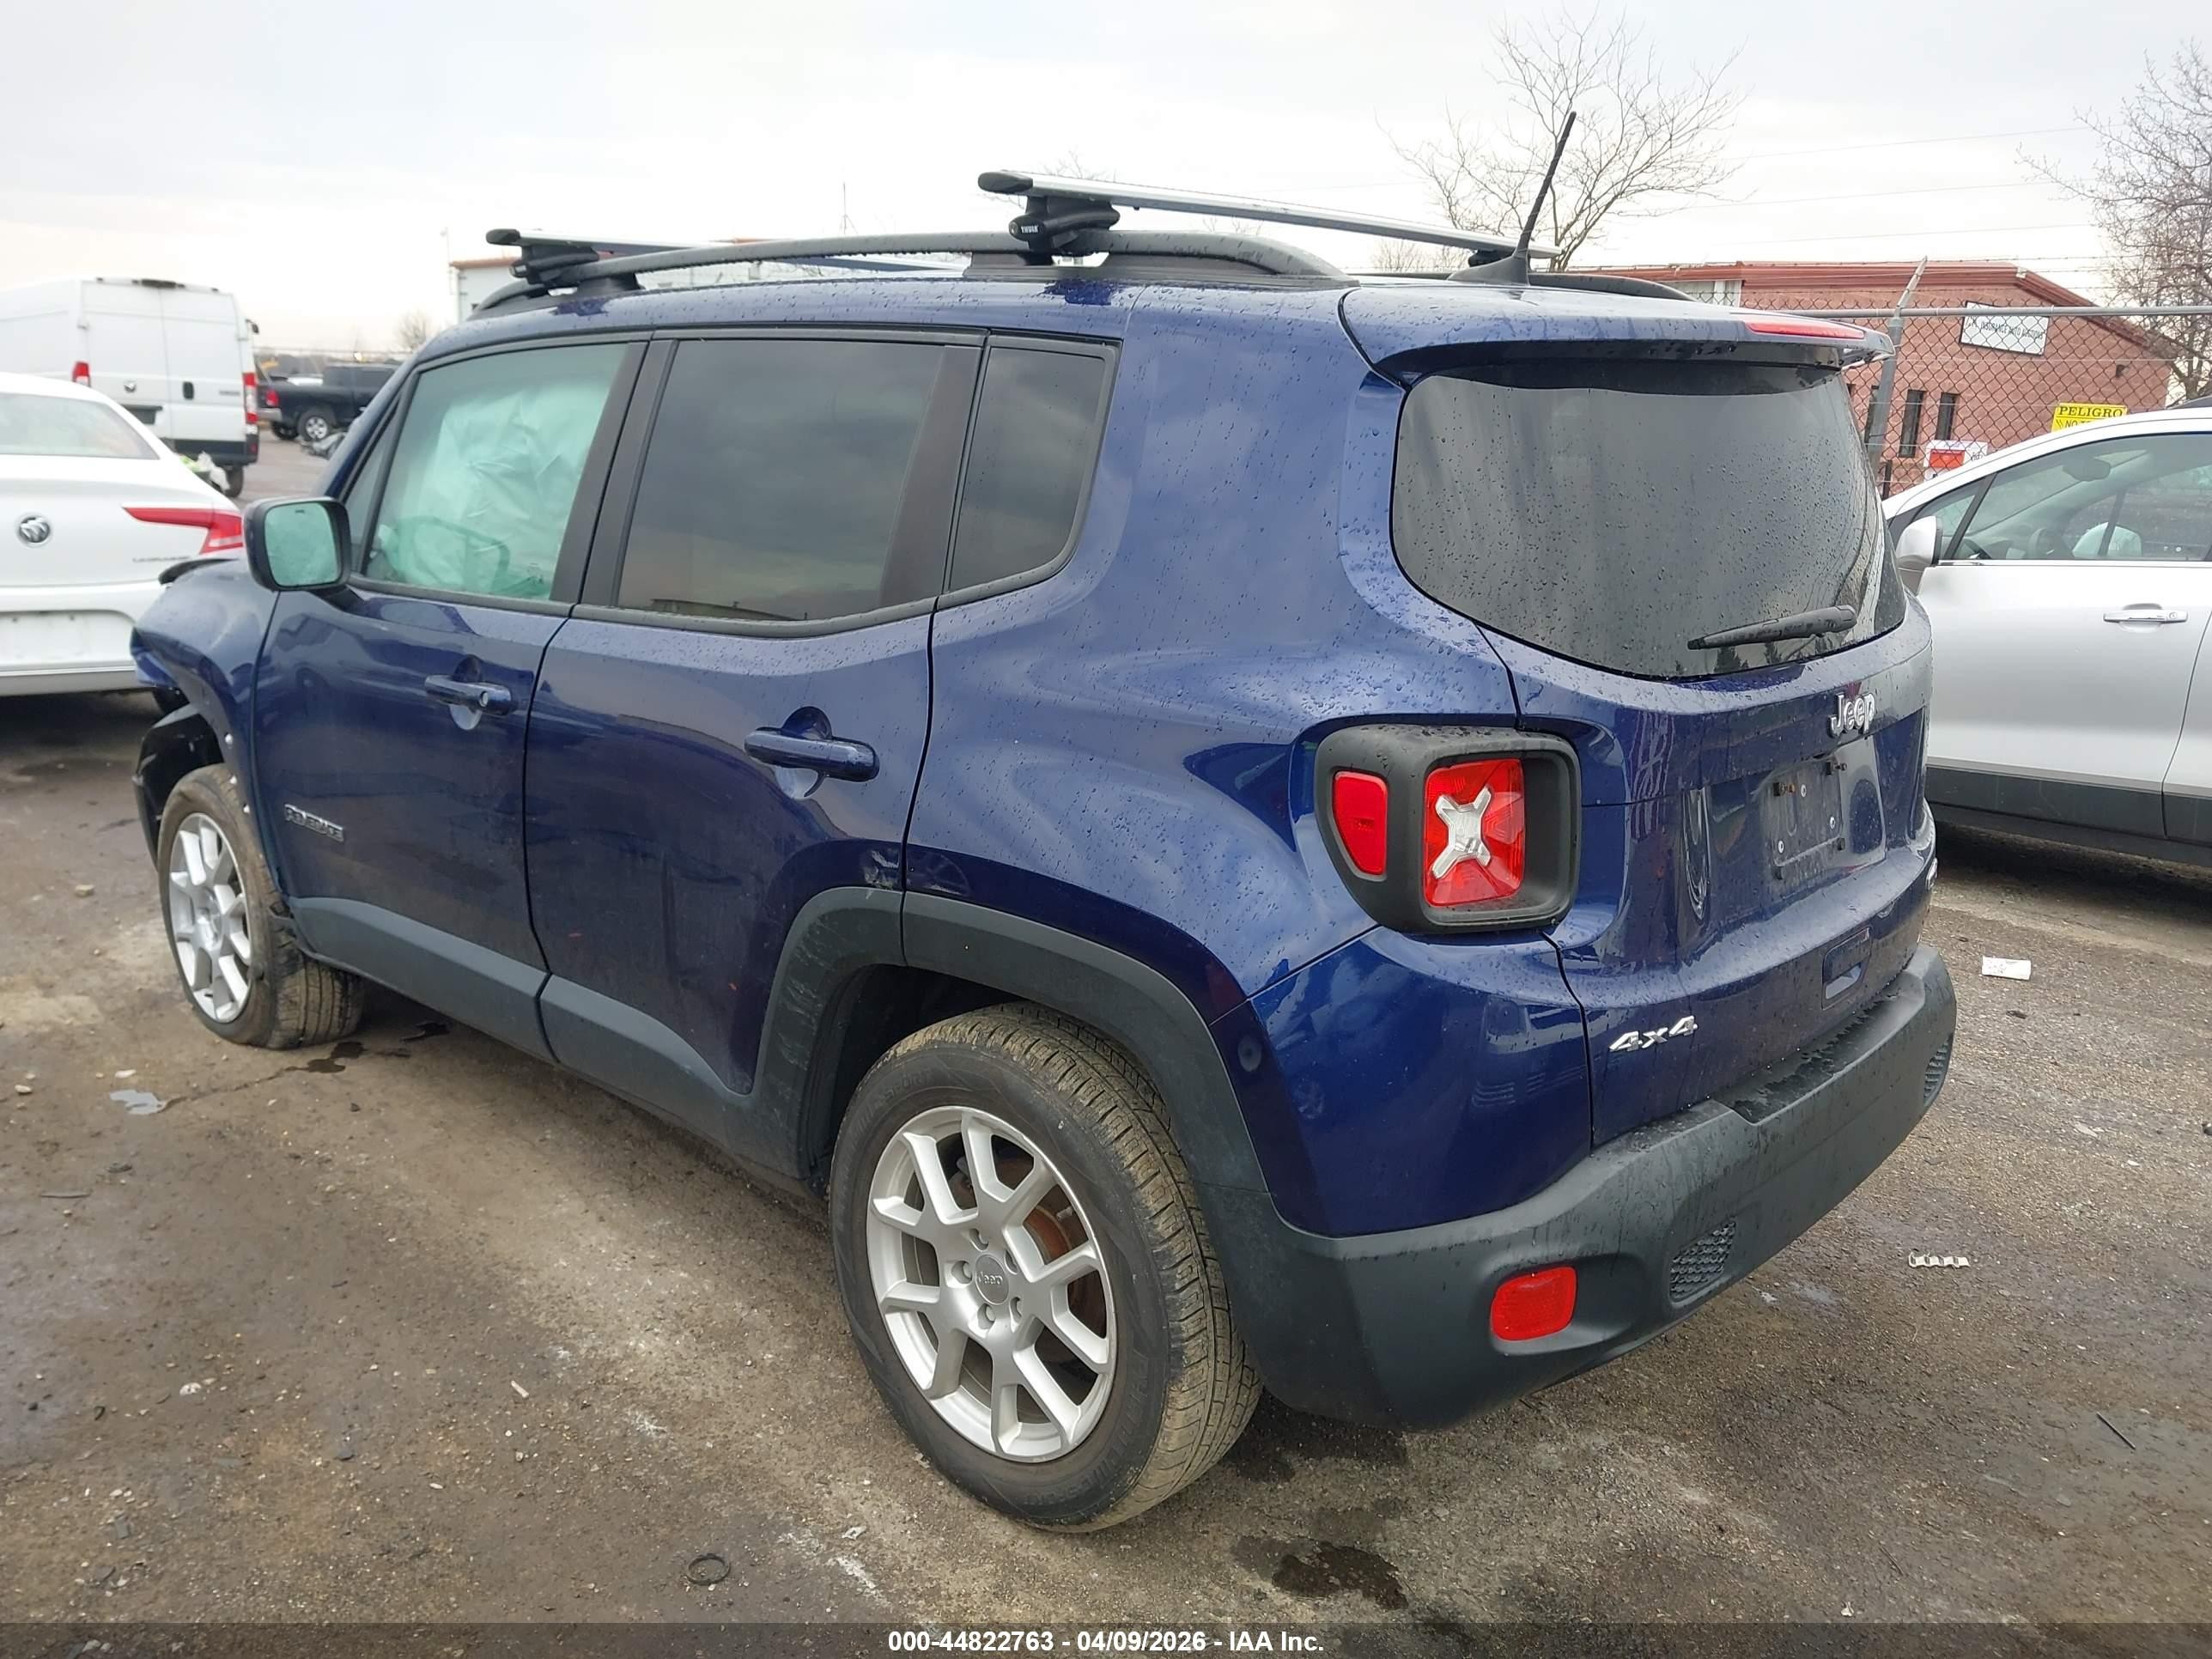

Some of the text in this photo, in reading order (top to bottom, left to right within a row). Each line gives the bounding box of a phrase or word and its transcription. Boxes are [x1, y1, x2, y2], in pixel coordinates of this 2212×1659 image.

[2058, 406, 2123, 418] PELIGRO
[1829, 692, 1875, 736] Jeep
[1609, 1015, 1698, 1052] 4x4
